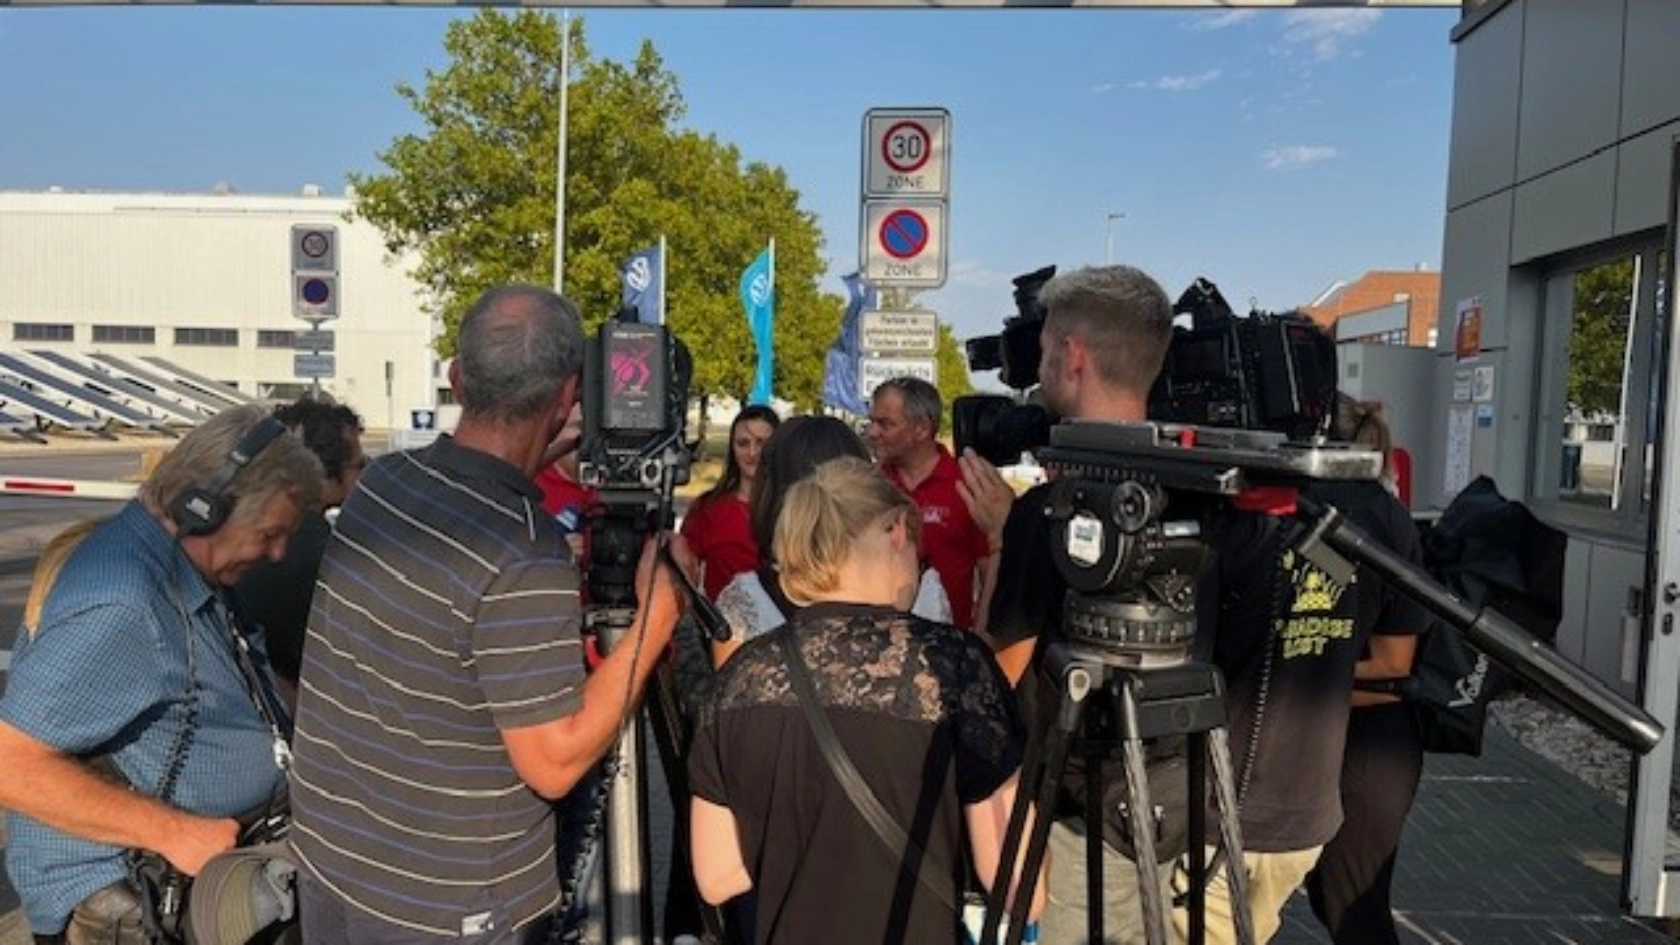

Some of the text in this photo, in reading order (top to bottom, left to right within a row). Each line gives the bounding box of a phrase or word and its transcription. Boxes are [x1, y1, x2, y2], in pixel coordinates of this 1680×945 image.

[892, 135, 922, 159] 30
[886, 175, 924, 189] ZONE
[884, 263, 922, 276] ZONE
